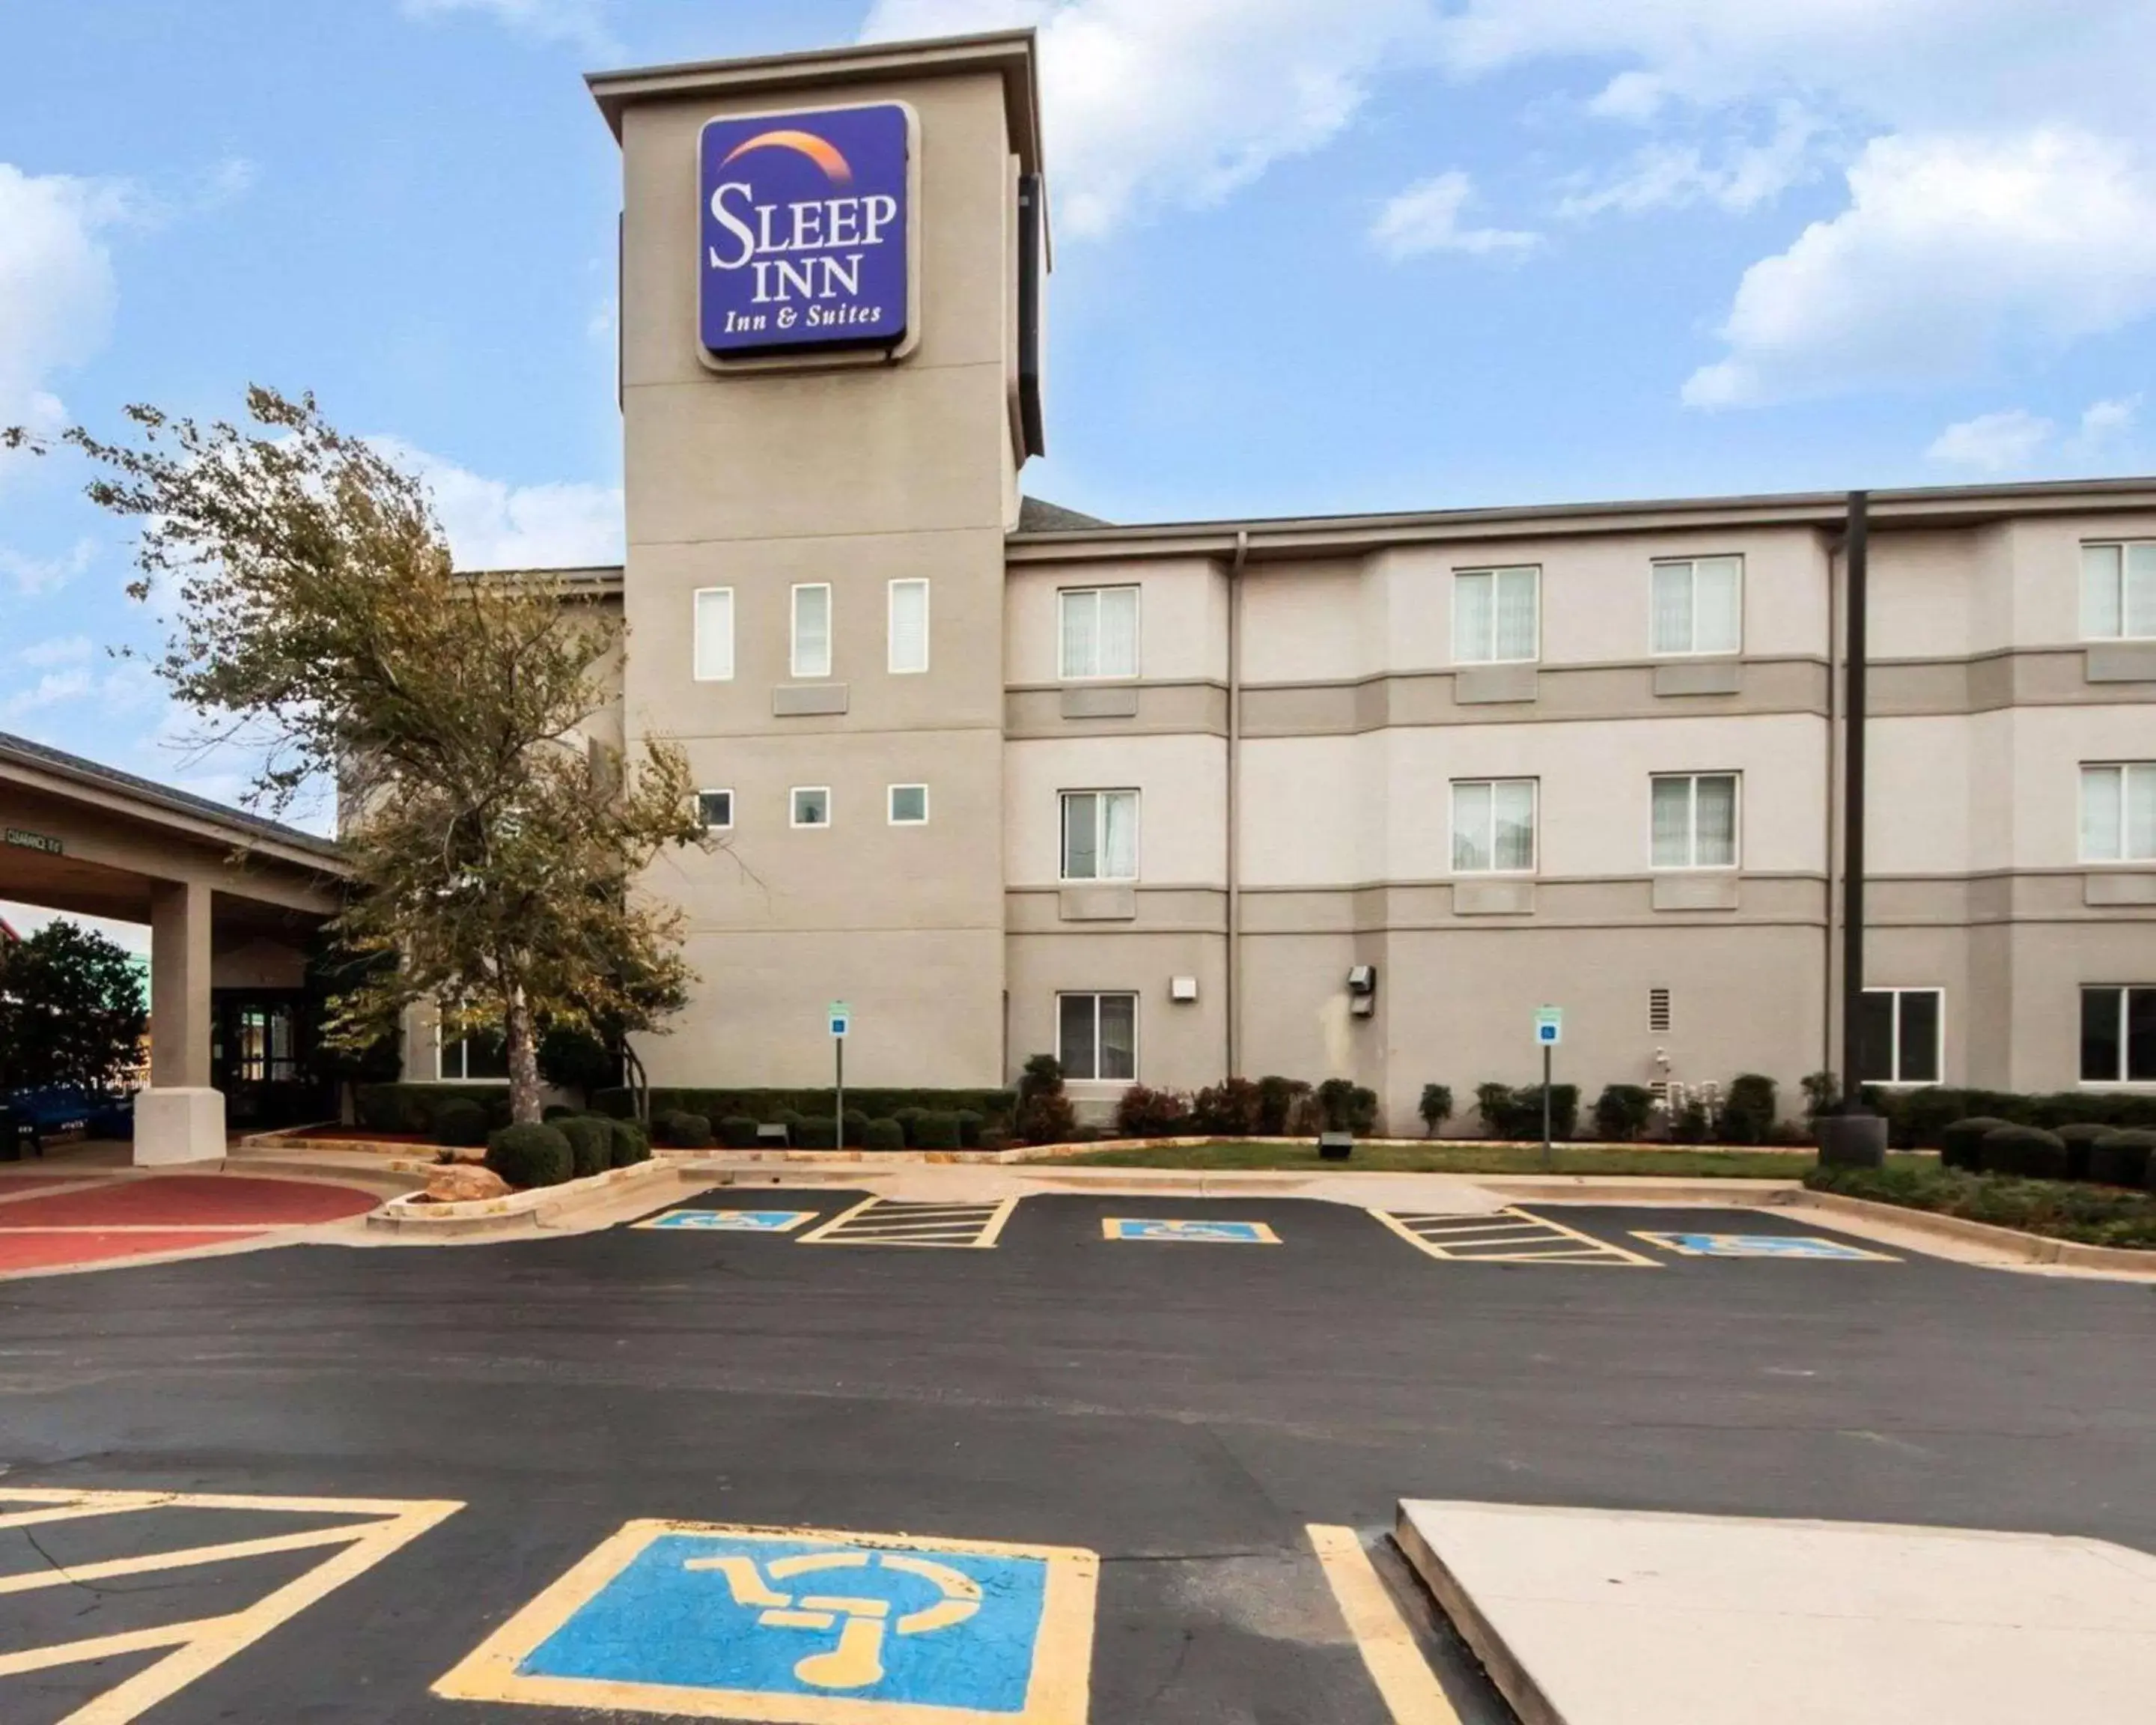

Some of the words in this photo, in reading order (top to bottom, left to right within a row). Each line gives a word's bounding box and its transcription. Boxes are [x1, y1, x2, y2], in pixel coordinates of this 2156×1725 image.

[710, 182, 897, 269] SLEEP
[751, 254, 864, 302] INN
[724, 311, 767, 333] Inn
[776, 306, 798, 329] &
[806, 302, 883, 327] Suites
